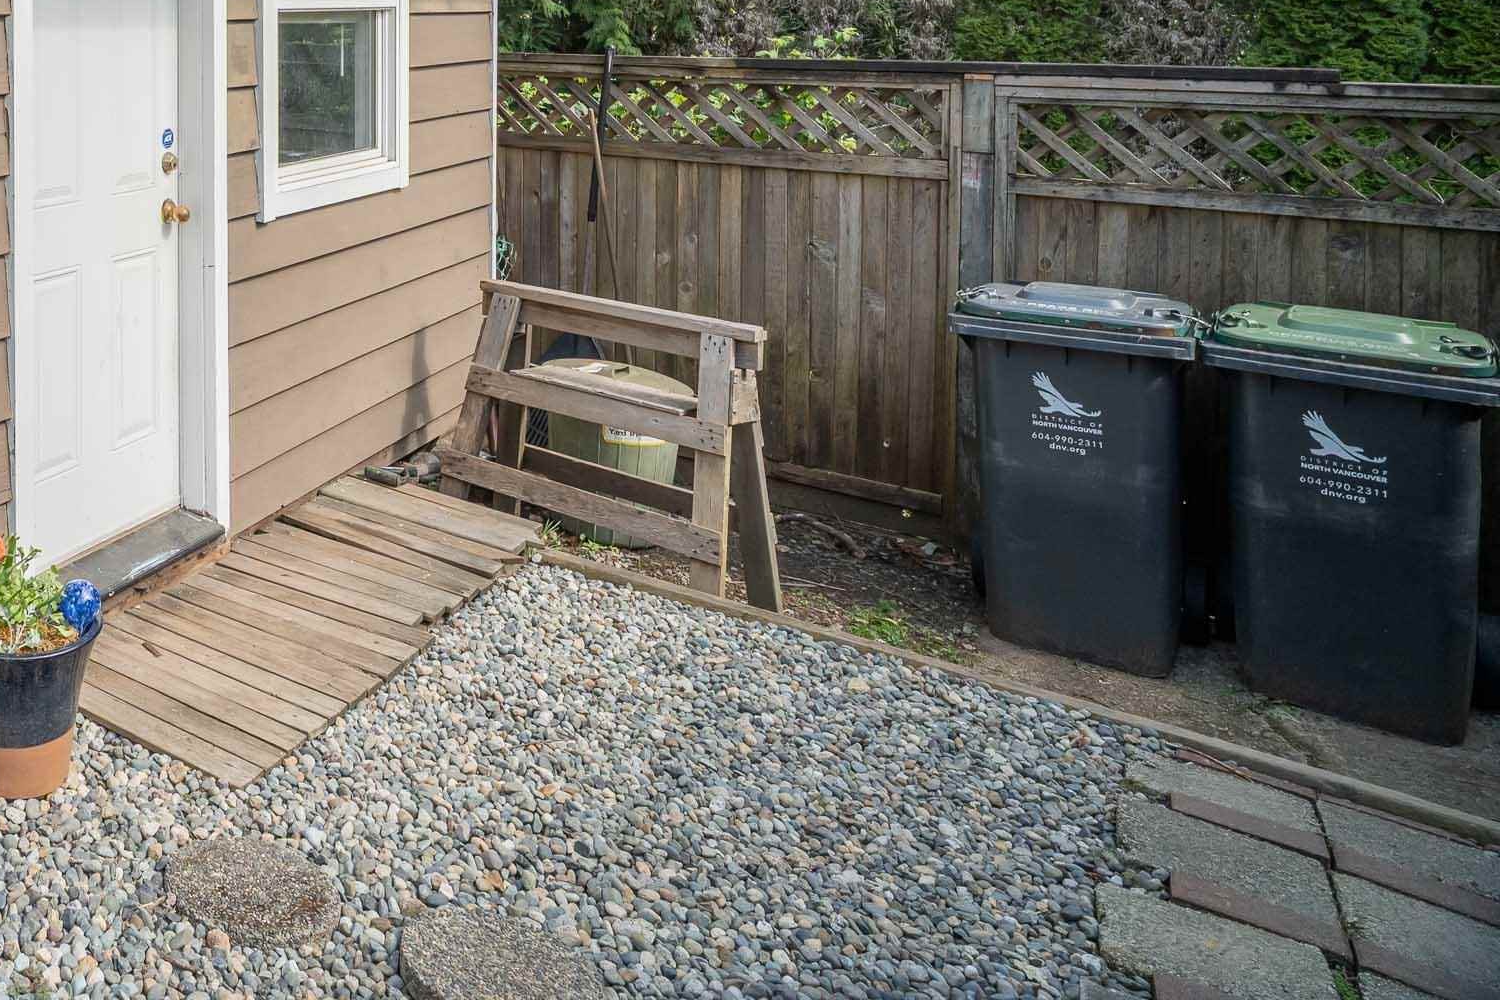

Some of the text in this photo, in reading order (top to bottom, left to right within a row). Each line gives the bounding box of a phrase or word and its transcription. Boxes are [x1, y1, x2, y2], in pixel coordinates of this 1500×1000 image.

[1031, 413, 1082, 425] DISTRICT
[1032, 420, 1103, 436] NORTH VANCOUVER
[1031, 431, 1103, 449] 604-990-2311
[1049, 442, 1086, 456] dnv.org
[1300, 455, 1388, 476] DISTRICT OF
[1300, 462, 1388, 484] NORTH VANCOUVER
[1299, 475, 1388, 499] 604-990-2311
[1320, 487, 1367, 504] dnv.org
